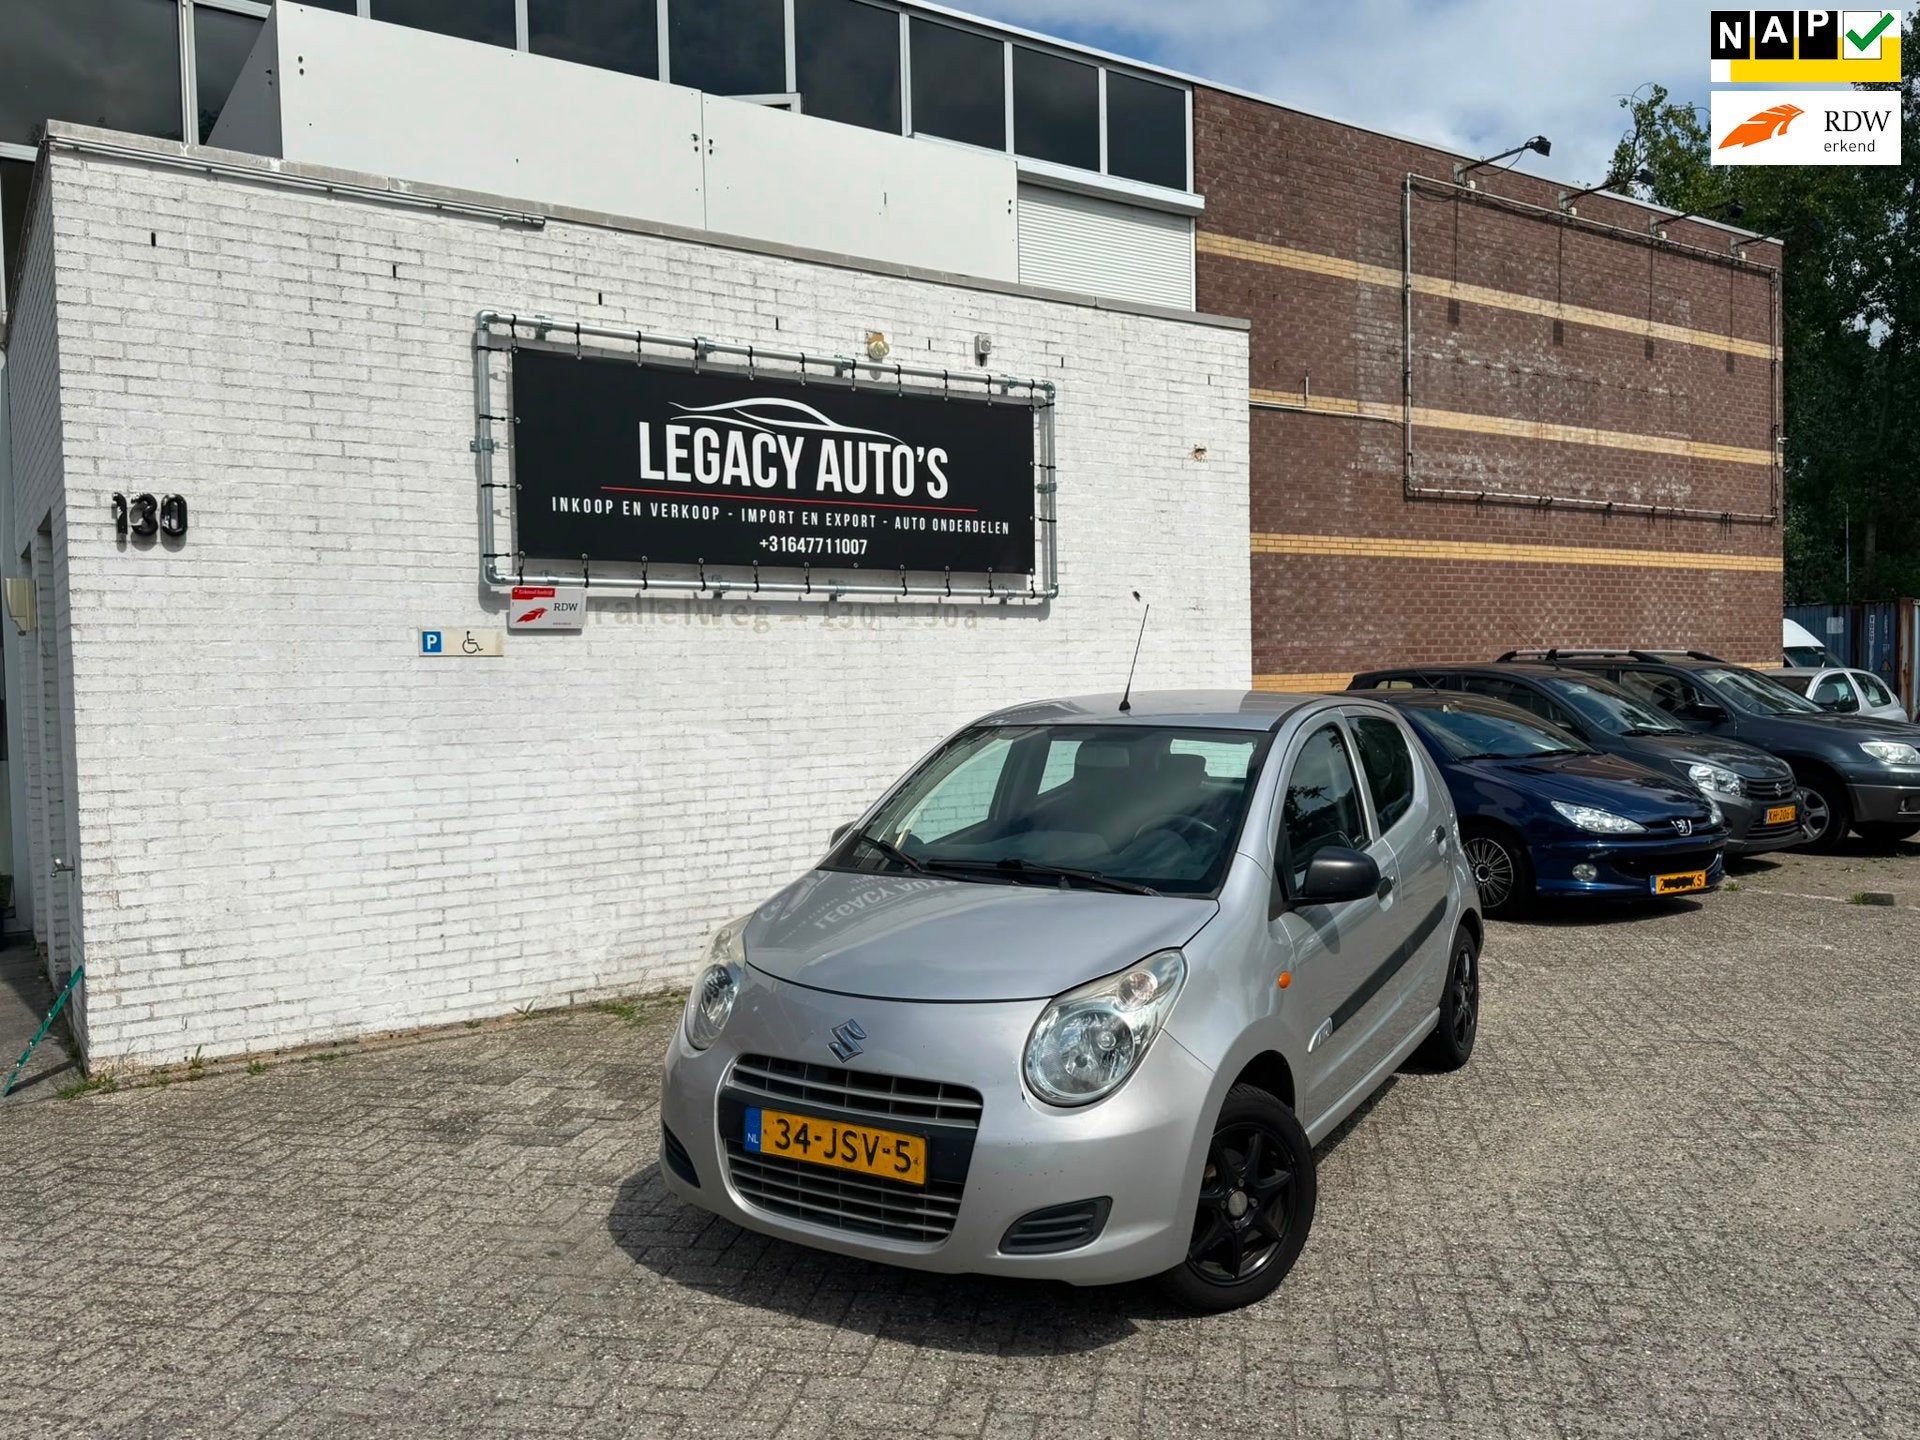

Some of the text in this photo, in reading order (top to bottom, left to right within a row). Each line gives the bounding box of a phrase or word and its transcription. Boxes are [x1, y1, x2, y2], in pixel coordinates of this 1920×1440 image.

[638, 421, 949, 499] LEGACY AUTO'S
[112, 492, 188, 537] 130
[551, 496, 614, 515] INKOOP
[622, 500, 642, 517] EN
[650, 502, 720, 521] VERKOOP
[741, 508, 795, 525] IMPORT
[802, 511, 819, 526] EN
[826, 512, 876, 529] EXPORT
[894, 516, 926, 531] AUTO
[932, 518, 1009, 535] ONDERDELEN
[759, 535, 868, 555] +31647711007
[553, 602, 578, 612] RDW
[426, 634, 438, 650] P
[747, 1118, 912, 1173] NL 34-JSV-5
